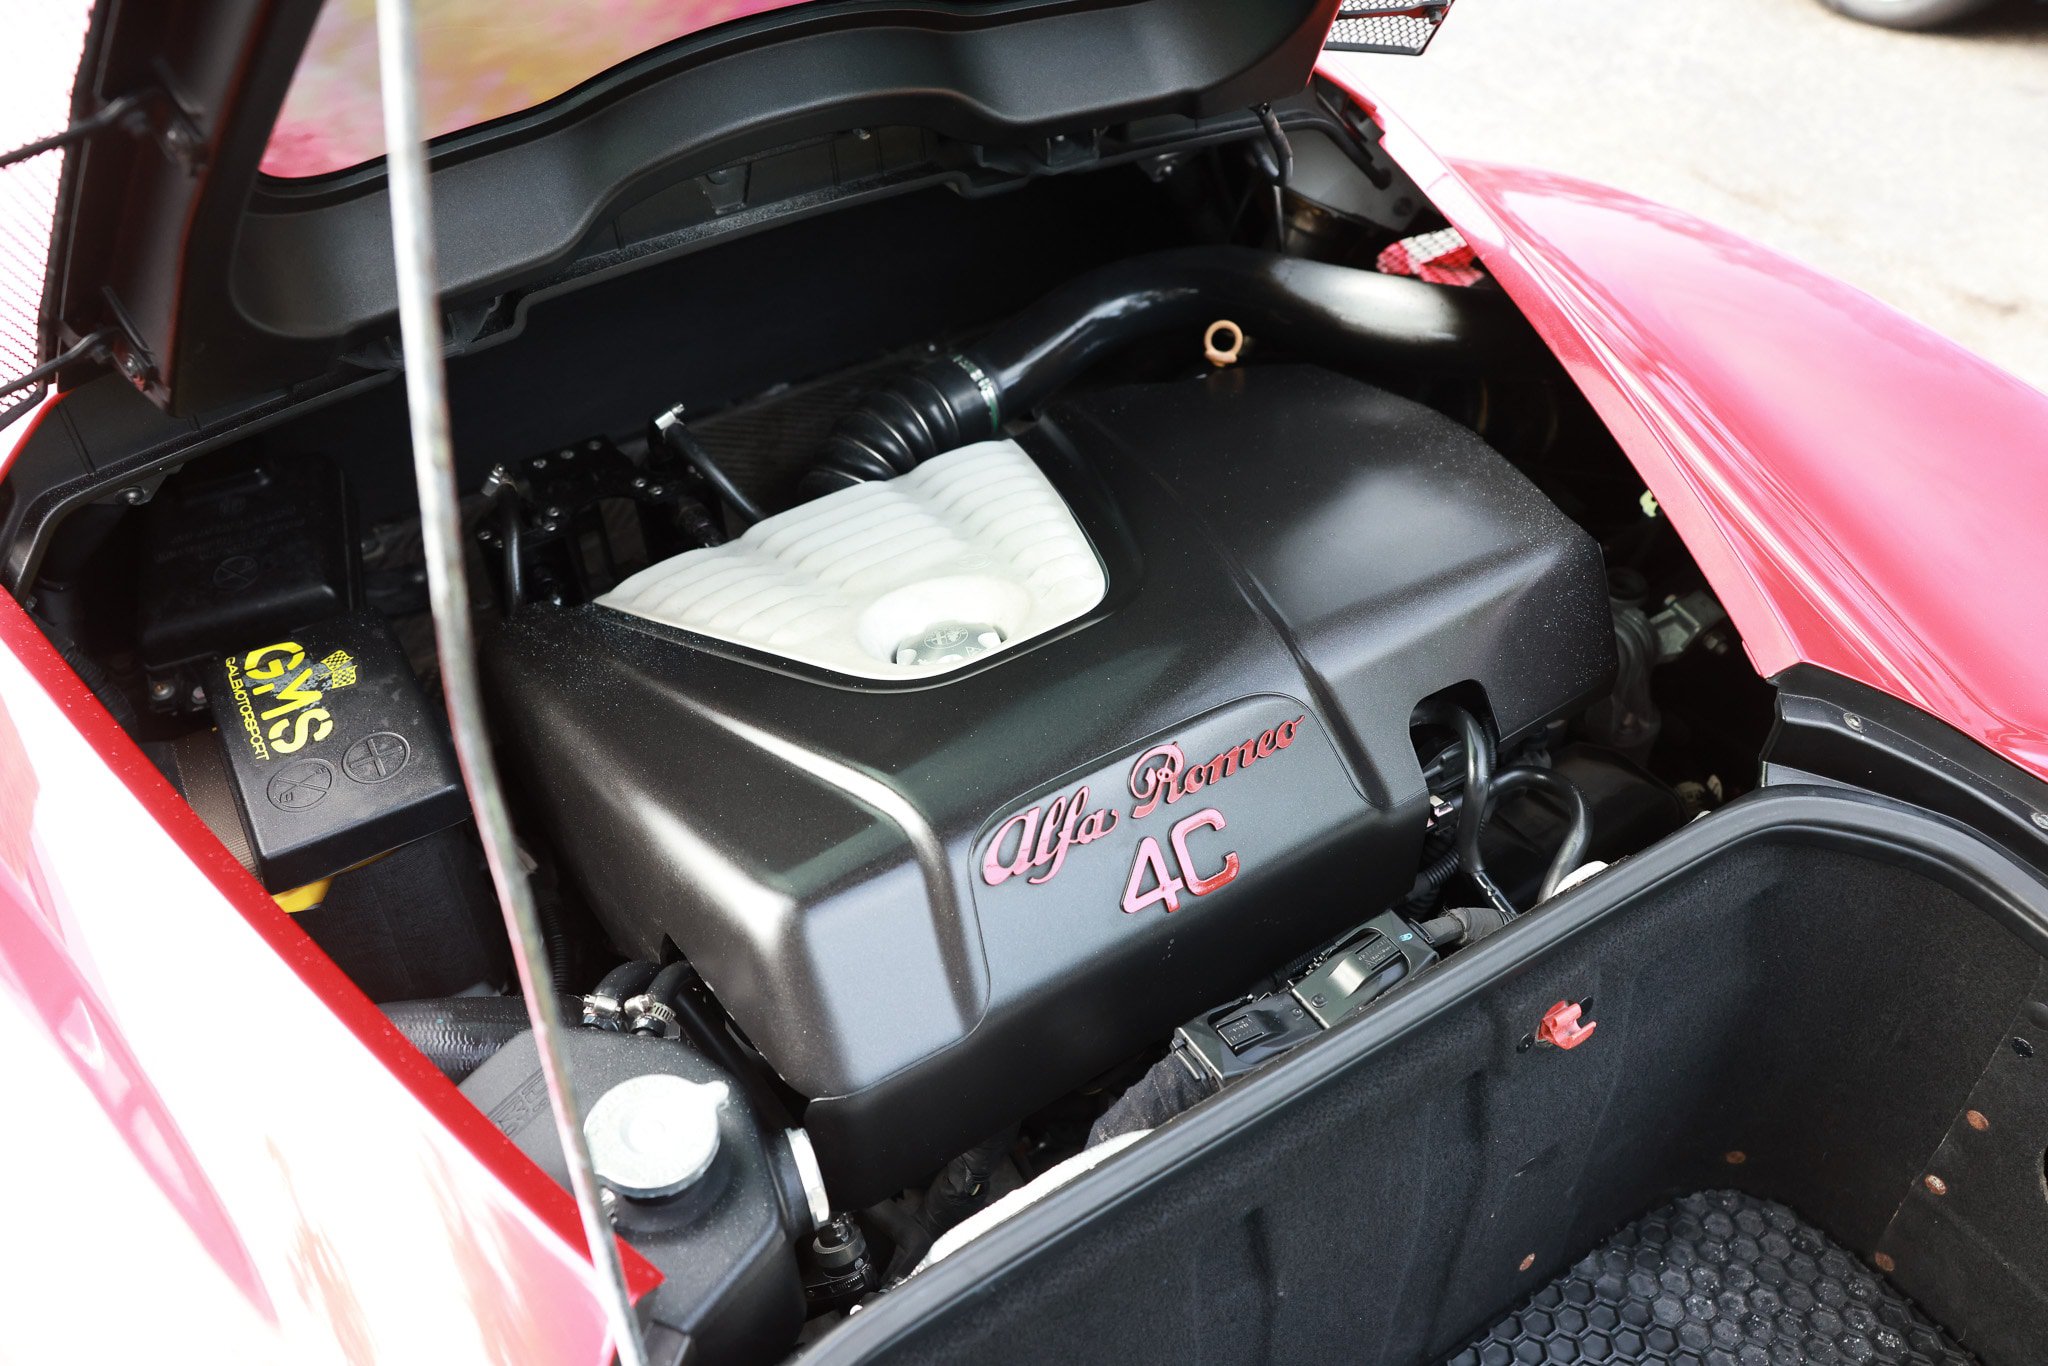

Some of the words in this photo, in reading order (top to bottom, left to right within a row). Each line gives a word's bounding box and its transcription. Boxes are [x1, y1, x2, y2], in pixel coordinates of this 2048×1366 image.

[225, 656, 270, 761] GALEMOTORSPORT
[244, 642, 333, 754] GMS
[981, 786, 1120, 886] Alfa
[1128, 715, 1306, 819] Romeo
[1120, 808, 1240, 914] 4C
